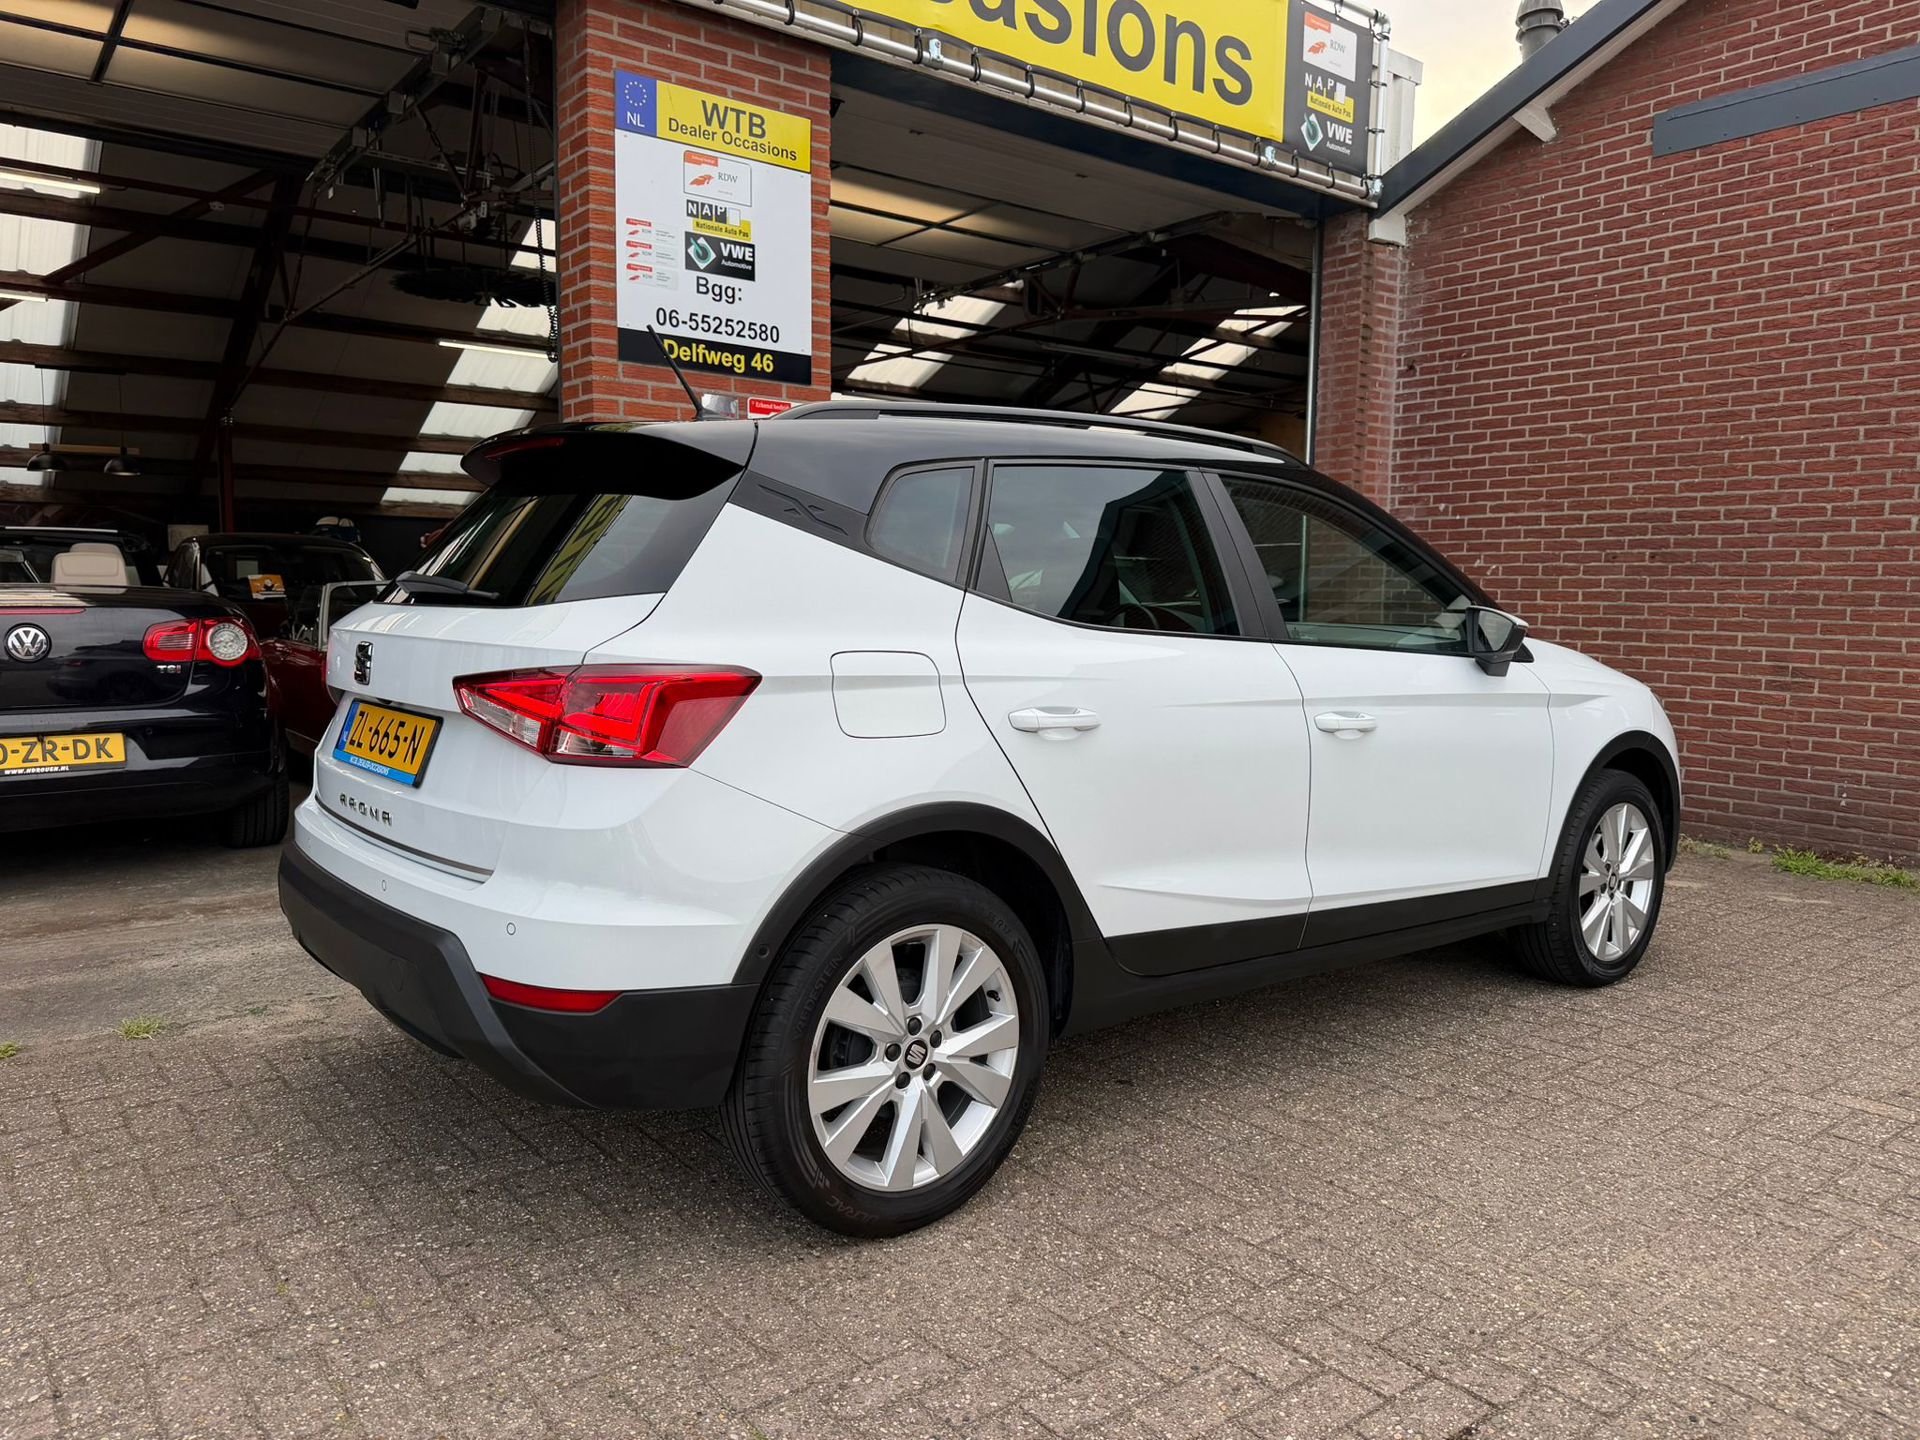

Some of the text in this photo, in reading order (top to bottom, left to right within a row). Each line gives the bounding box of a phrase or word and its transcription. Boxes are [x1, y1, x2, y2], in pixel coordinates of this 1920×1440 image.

[626, 111, 645, 128] NL
[701, 99, 766, 139] WTB
[668, 117, 717, 142] Dealer
[722, 131, 797, 161] Occasions
[1326, 121, 1353, 145] VWE
[718, 171, 738, 183] RDW
[695, 221, 749, 238] Nationale Auto Pas
[720, 241, 753, 262] VWE
[721, 259, 752, 271] Automotive
[696, 275, 743, 305] Bgg:
[656, 307, 780, 344] 06-55252580
[663, 338, 775, 374] Delfweg 46
[156, 664, 182, 674] TSI
[348, 710, 426, 765] ZL-665-N
[339, 794, 393, 827] ARONA
